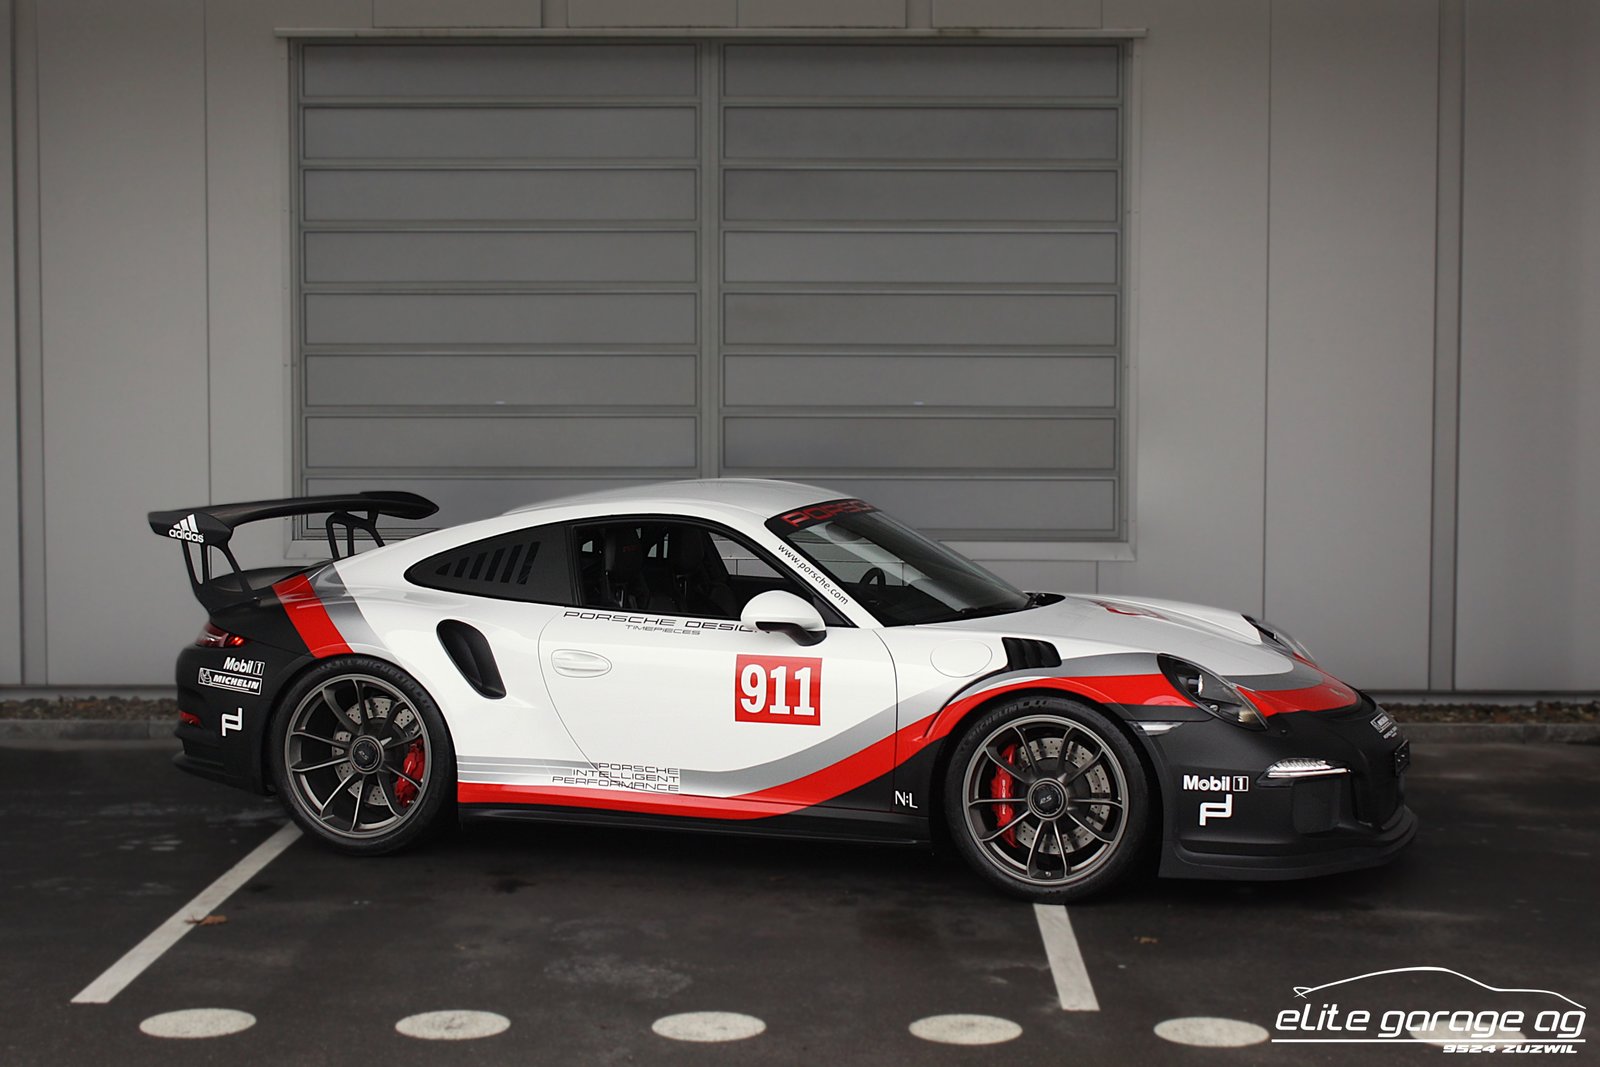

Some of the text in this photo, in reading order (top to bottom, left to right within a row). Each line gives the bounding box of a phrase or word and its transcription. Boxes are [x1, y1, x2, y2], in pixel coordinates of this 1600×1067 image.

[168, 528, 204, 543] adidas
[777, 544, 849, 605] www.porsche.com
[563, 610, 677, 627] PORSCHE
[625, 625, 701, 635] TIMEPIECES
[223, 656, 254, 674] Mobil
[213, 674, 259, 690] MICHELIN
[740, 663, 815, 716] 911
[572, 769, 679, 782] INTELLIGENT
[598, 762, 679, 775] PORSCHE
[552, 776, 679, 791] PERFORMANCE
[1183, 775, 1230, 791] Mobil
